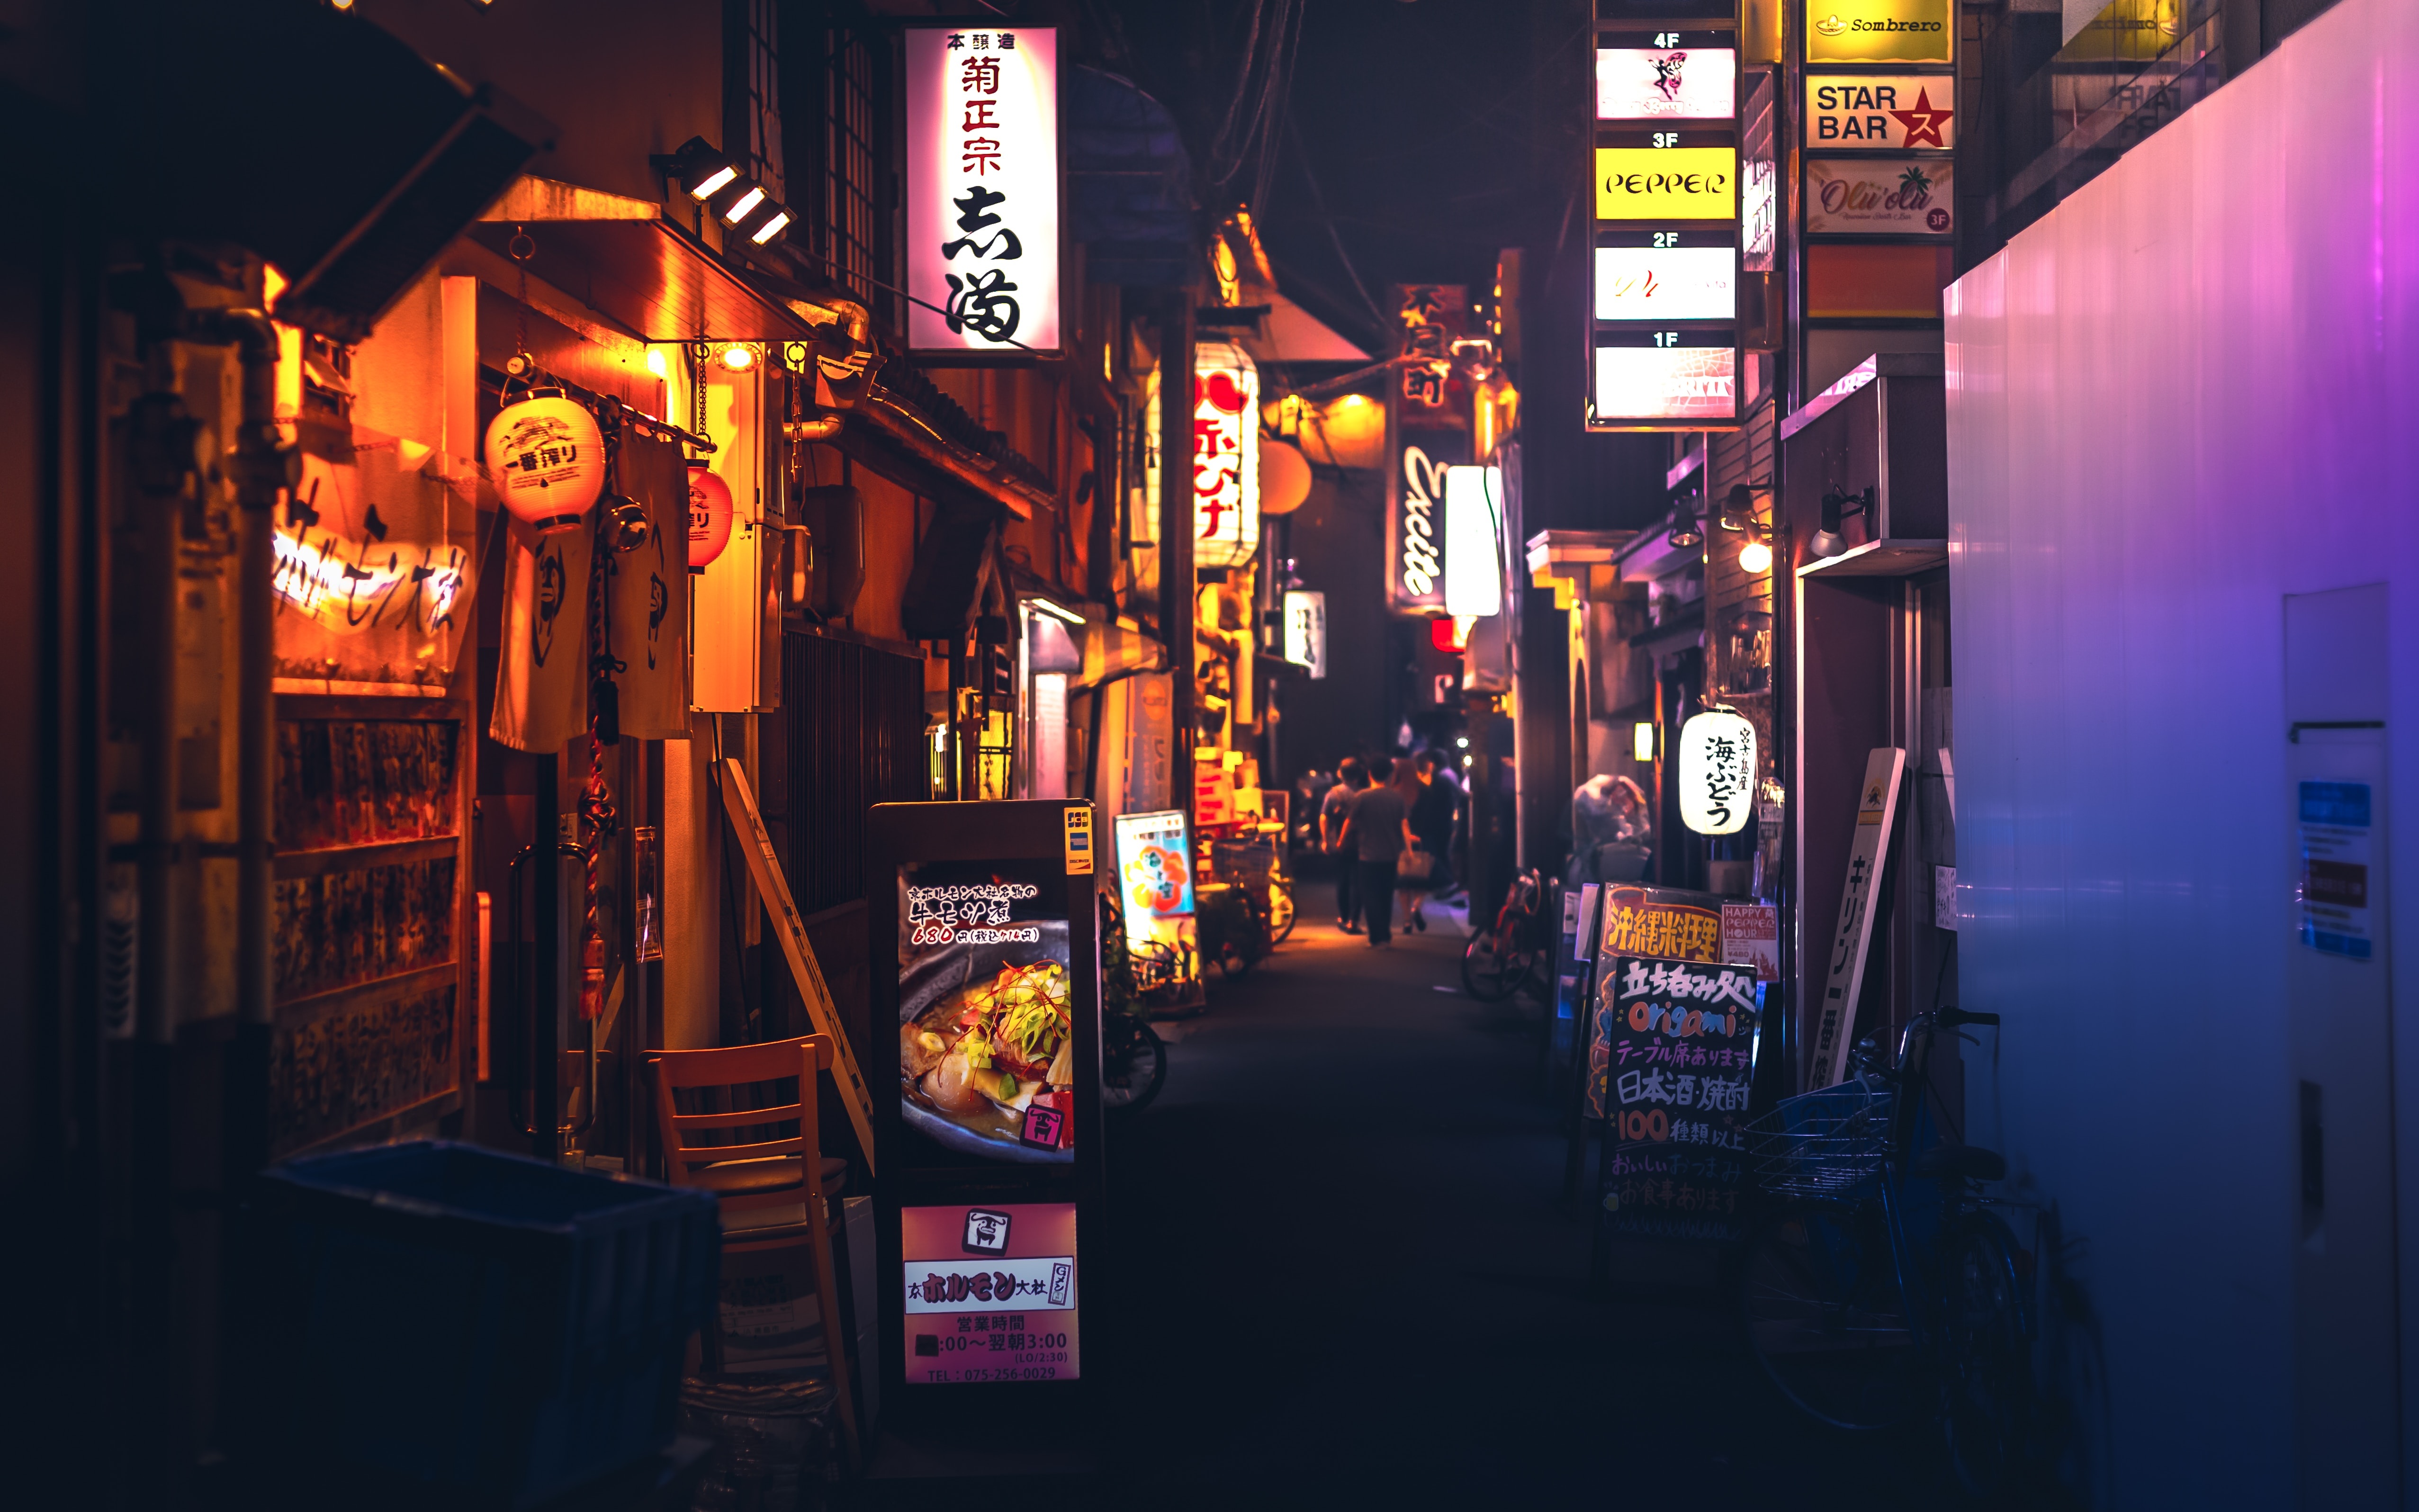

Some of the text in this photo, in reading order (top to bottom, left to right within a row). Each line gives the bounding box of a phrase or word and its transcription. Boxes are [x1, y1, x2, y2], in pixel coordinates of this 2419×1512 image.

[1851, 19, 1942, 33] Sombrero
[947, 33, 1015, 50] 本醸造
[1654, 33, 1679, 48] 4F
[1817, 86, 1896, 110] STAR
[962, 56, 1001, 176] 菊正宗
[1911, 113, 1932, 136] ス
[1818, 116, 1887, 140] BAR
[1653, 133, 1678, 148] 3F
[1606, 173, 1726, 194] PEPPER
[1931, 215, 1946, 225] 3F
[1654, 233, 1678, 247] 2F
[1654, 332, 1678, 347] 1F
[505, 444, 577, 472] 一番搾り
[1404, 446, 1448, 596] Excite
[1736, 727, 1751, 790] 宮古島産
[1705, 736, 1737, 826] 海ぶどう
[908, 885, 1036, 900] 京ホルモン大社名物の
[910, 900, 1010, 926] 牛モツ煮
[1726, 908, 1762, 918] HAPPY
[1726, 918, 1775, 928] PEPPER
[1608, 906, 1718, 963] 沖縄料理
[1726, 928, 1757, 938] HOUR
[1619, 960, 1755, 1014] 立ち呑み処
[1617, 1036, 1750, 1071] テーブル席あります
[908, 1271, 1048, 1304] 京ホルモン大社
[957, 1315, 1025, 1333] 営業時間
[1015, 1351, 1068, 1364] (LO/2:30)
